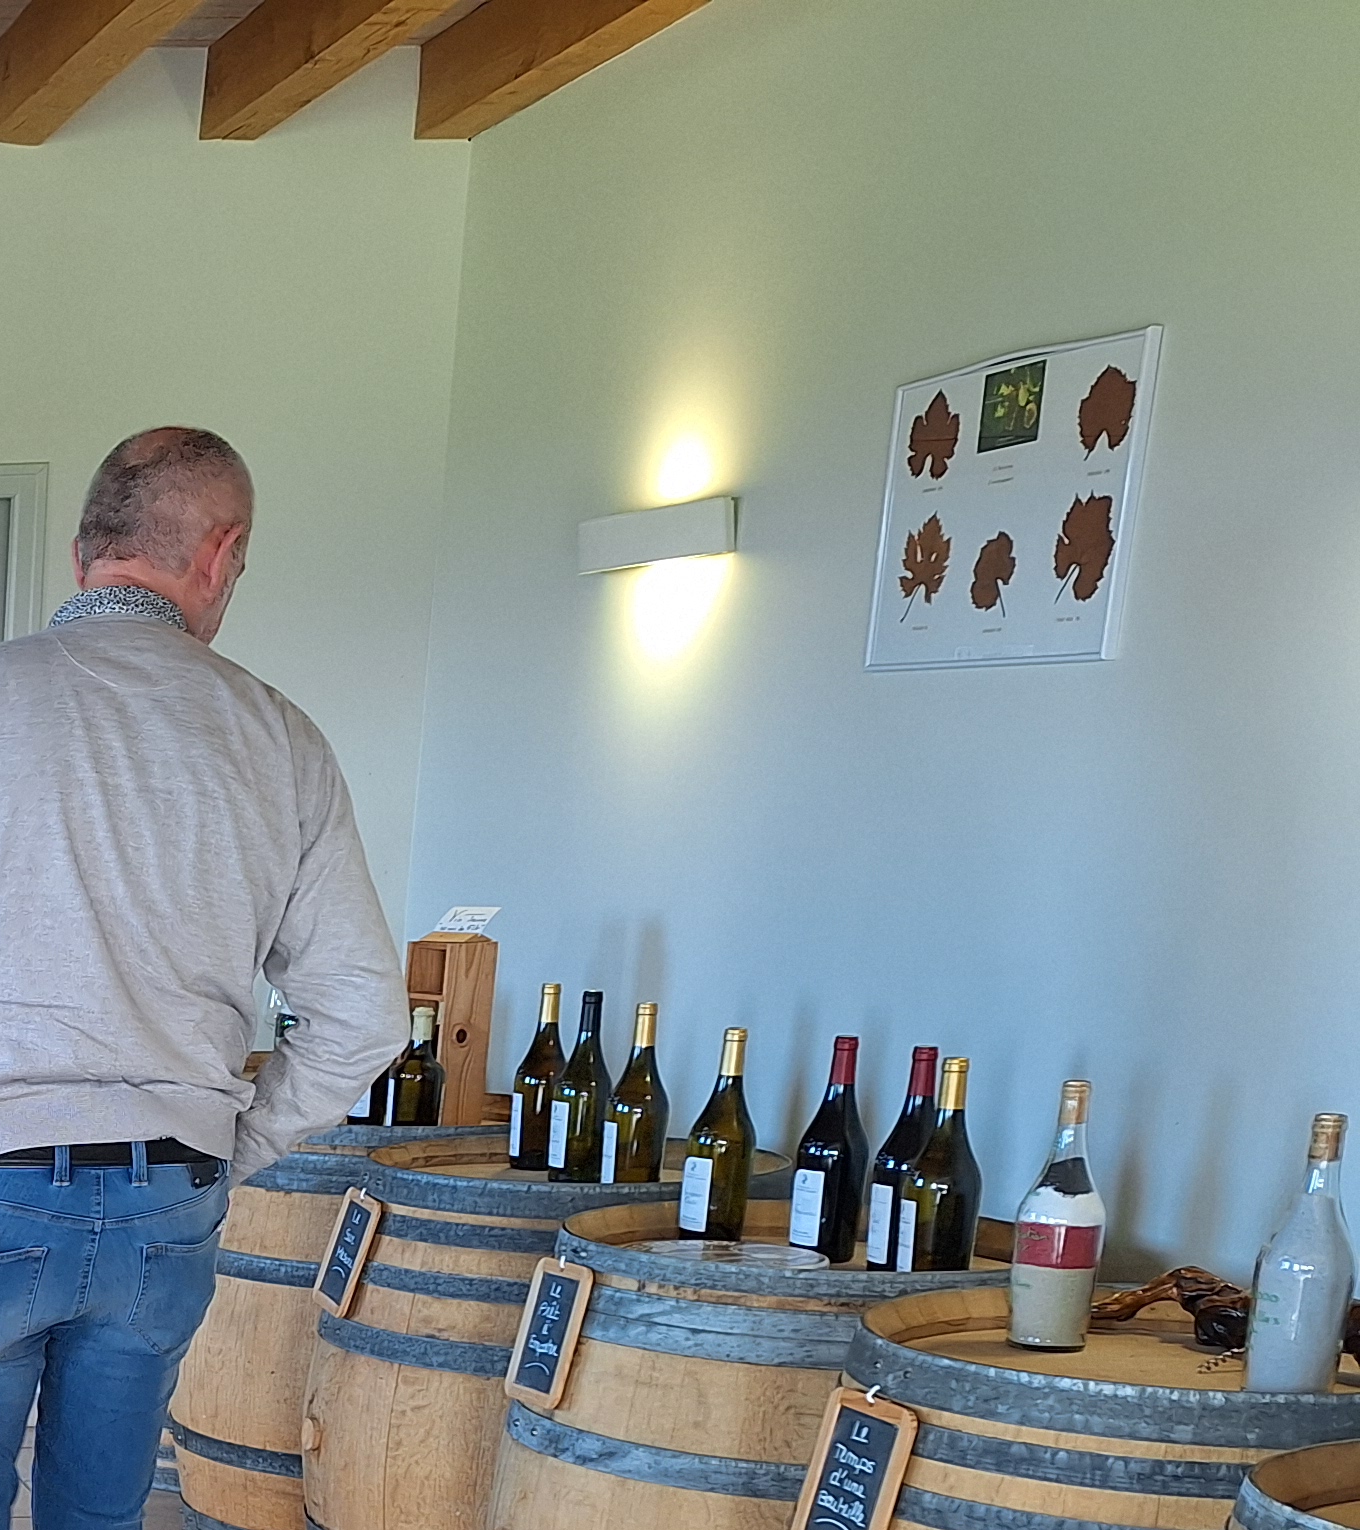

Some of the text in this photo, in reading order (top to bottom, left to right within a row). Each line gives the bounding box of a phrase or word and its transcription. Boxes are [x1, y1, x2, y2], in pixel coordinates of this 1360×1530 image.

[351, 1208, 362, 1225] Le
[549, 1281, 562, 1299] Le
[849, 1419, 869, 1443] Le
[833, 1442, 877, 1475] Temps
[828, 1467, 867, 1499] d'une
